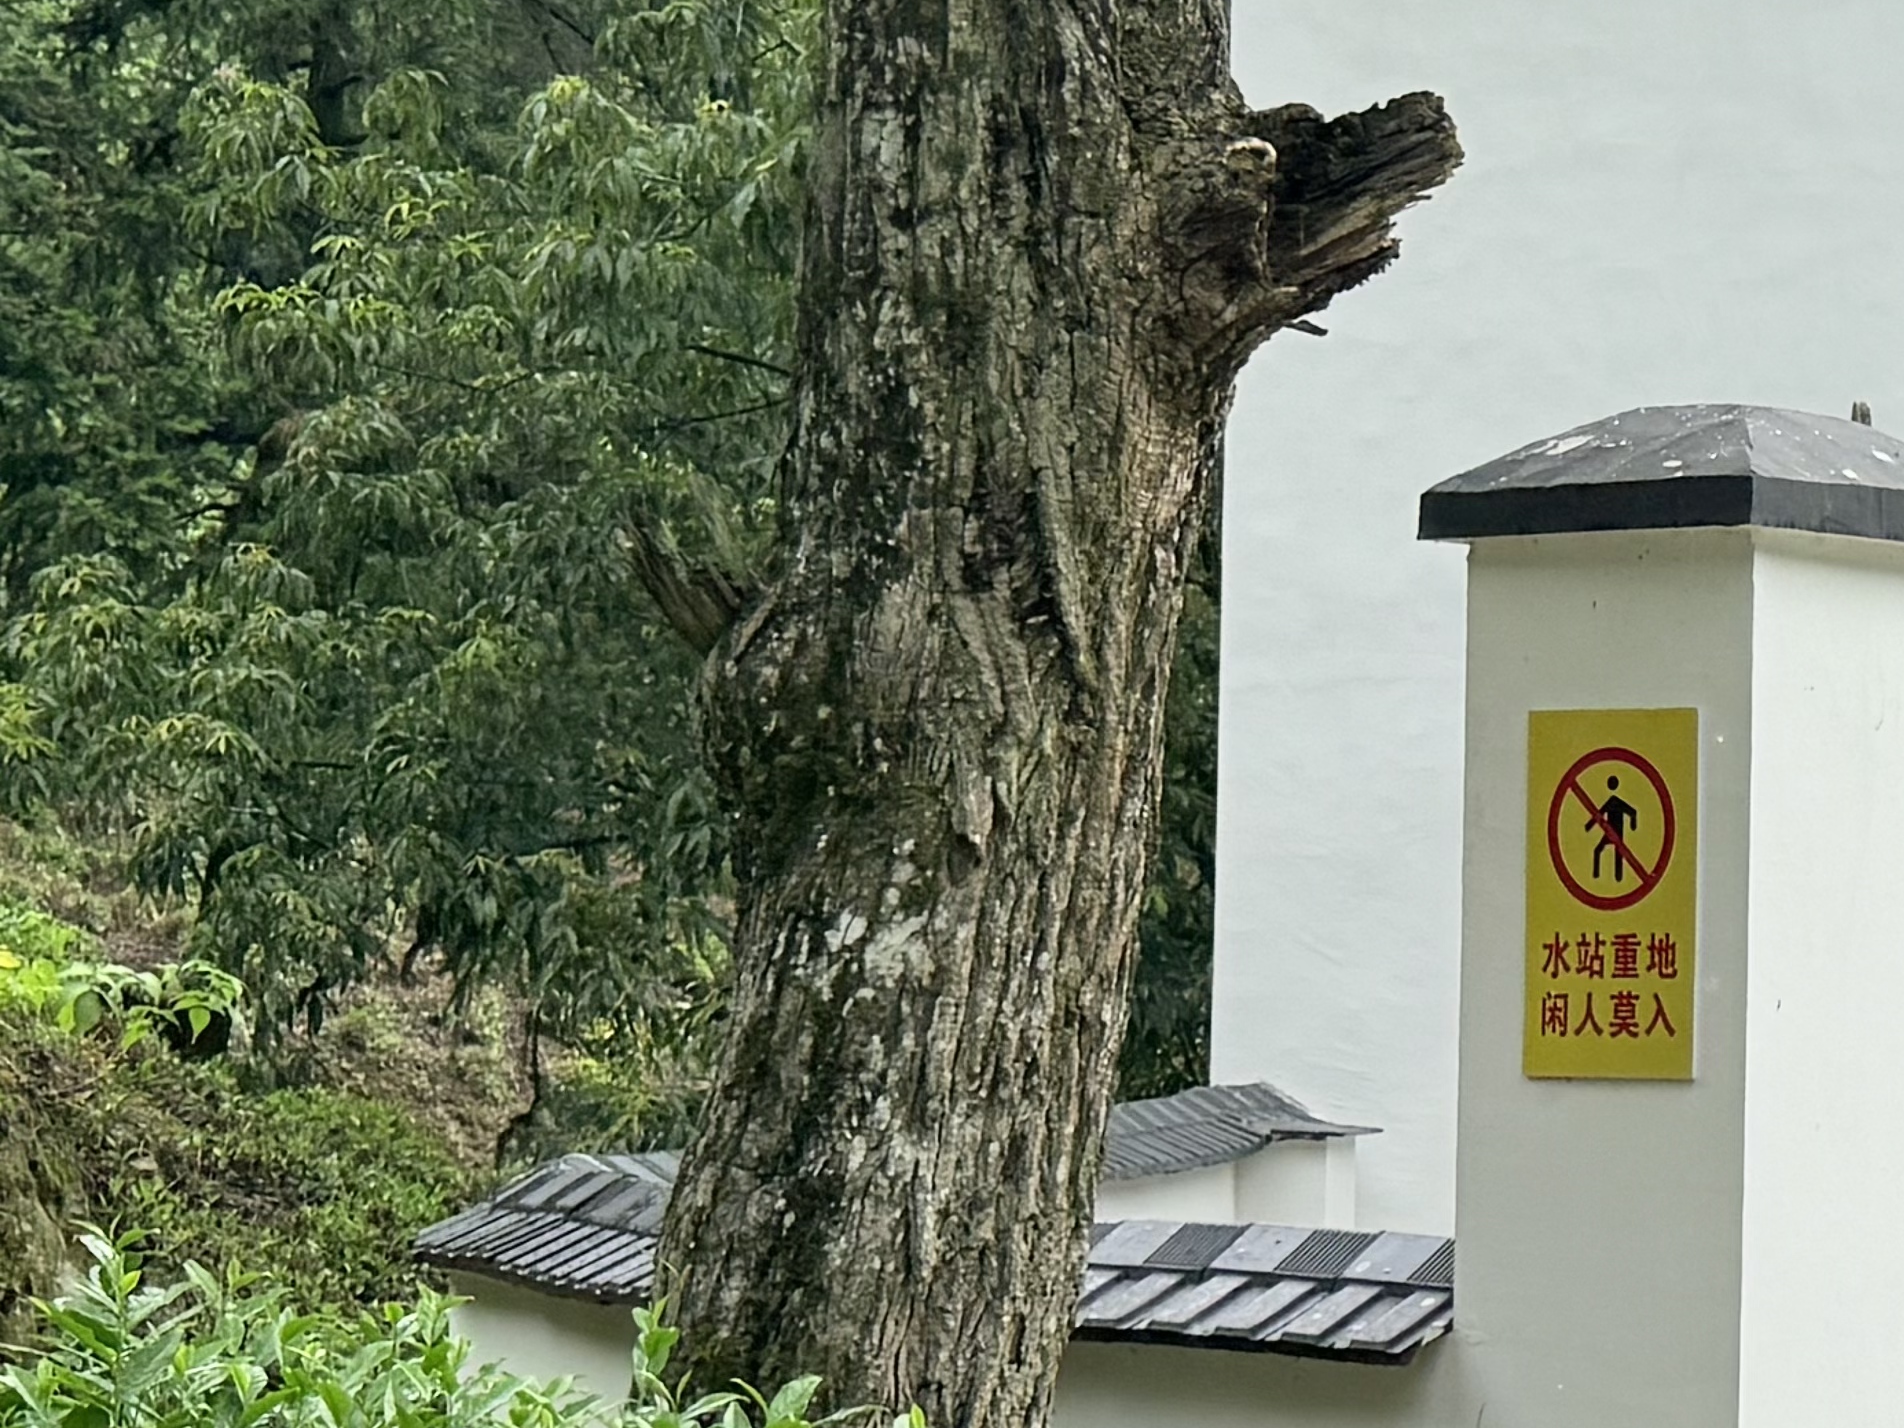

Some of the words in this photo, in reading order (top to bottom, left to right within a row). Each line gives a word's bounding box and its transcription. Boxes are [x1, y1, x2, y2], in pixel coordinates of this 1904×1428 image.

[1541, 932, 1679, 981] 水站重地
[1540, 990, 1677, 1039] 闲人莫入
